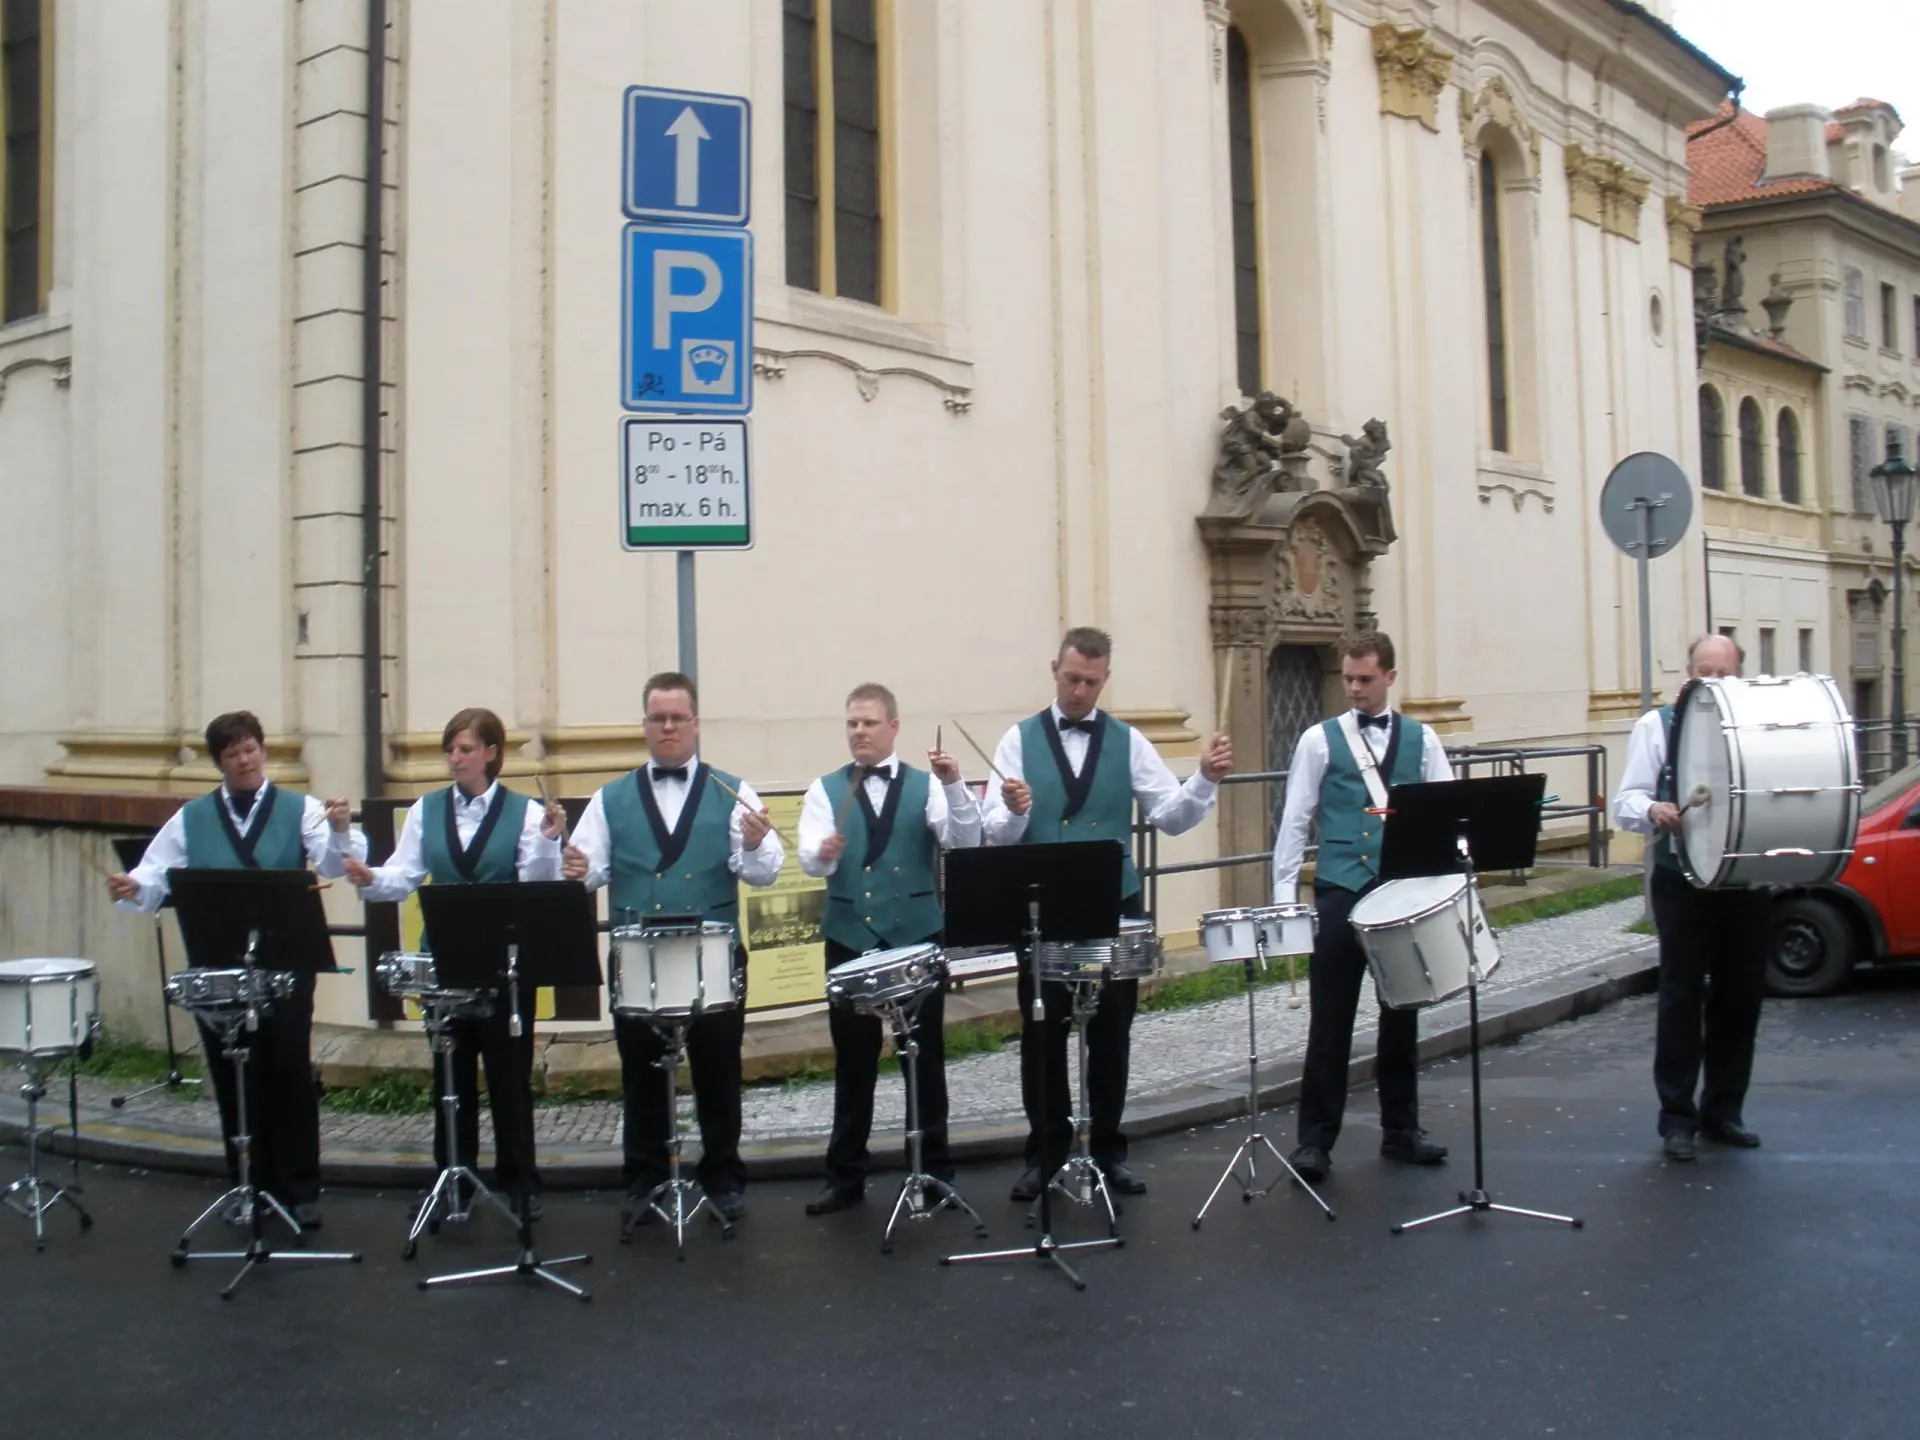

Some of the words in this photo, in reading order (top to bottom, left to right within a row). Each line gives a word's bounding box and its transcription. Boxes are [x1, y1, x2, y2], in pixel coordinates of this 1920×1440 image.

[653, 249, 724, 350] P
[647, 431, 676, 452] Po
[699, 431, 726, 452] Pá
[639, 502, 693, 518] max.
[699, 497, 712, 518] 6
